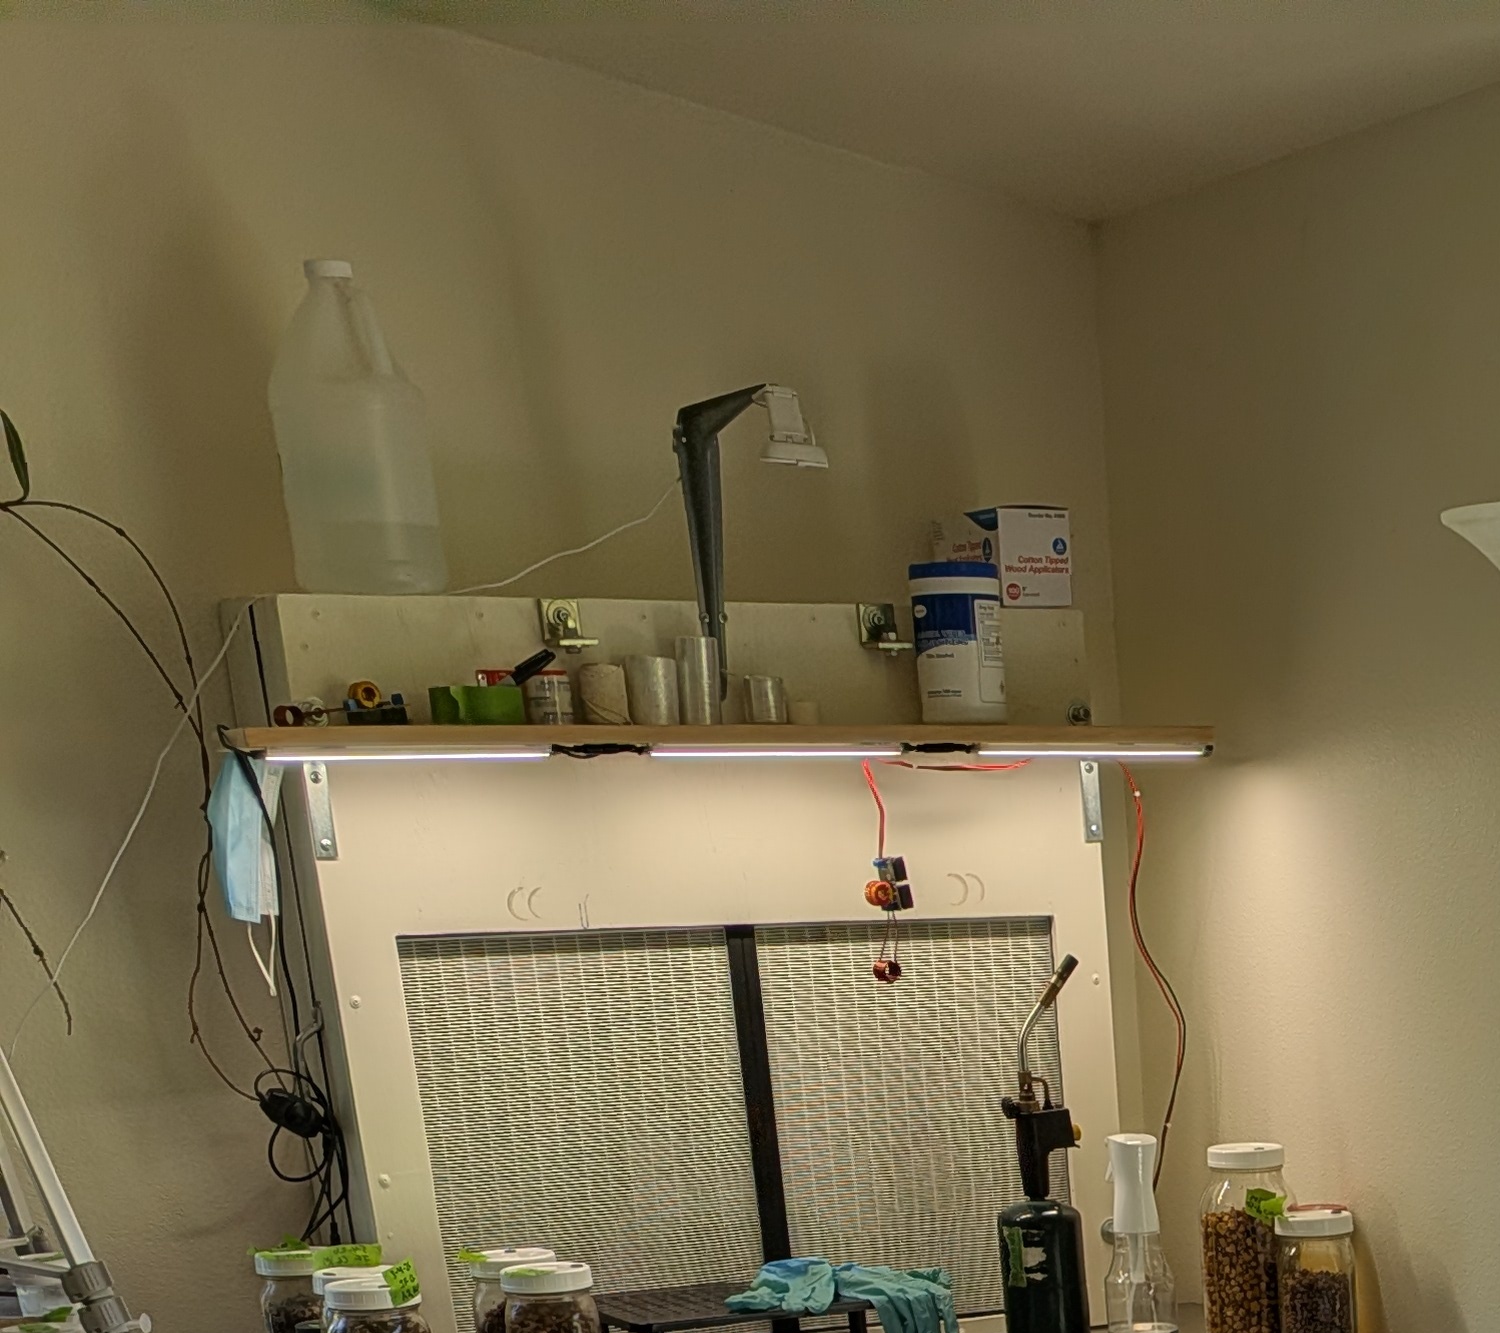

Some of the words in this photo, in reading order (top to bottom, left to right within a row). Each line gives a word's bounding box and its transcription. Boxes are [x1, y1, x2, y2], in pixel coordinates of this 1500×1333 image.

[1018, 555, 1042, 564] Cotton
[1045, 555, 1069, 565] Tipped
[1004, 564, 1027, 573] Wood
[1028, 565, 1069, 575] Applicators
